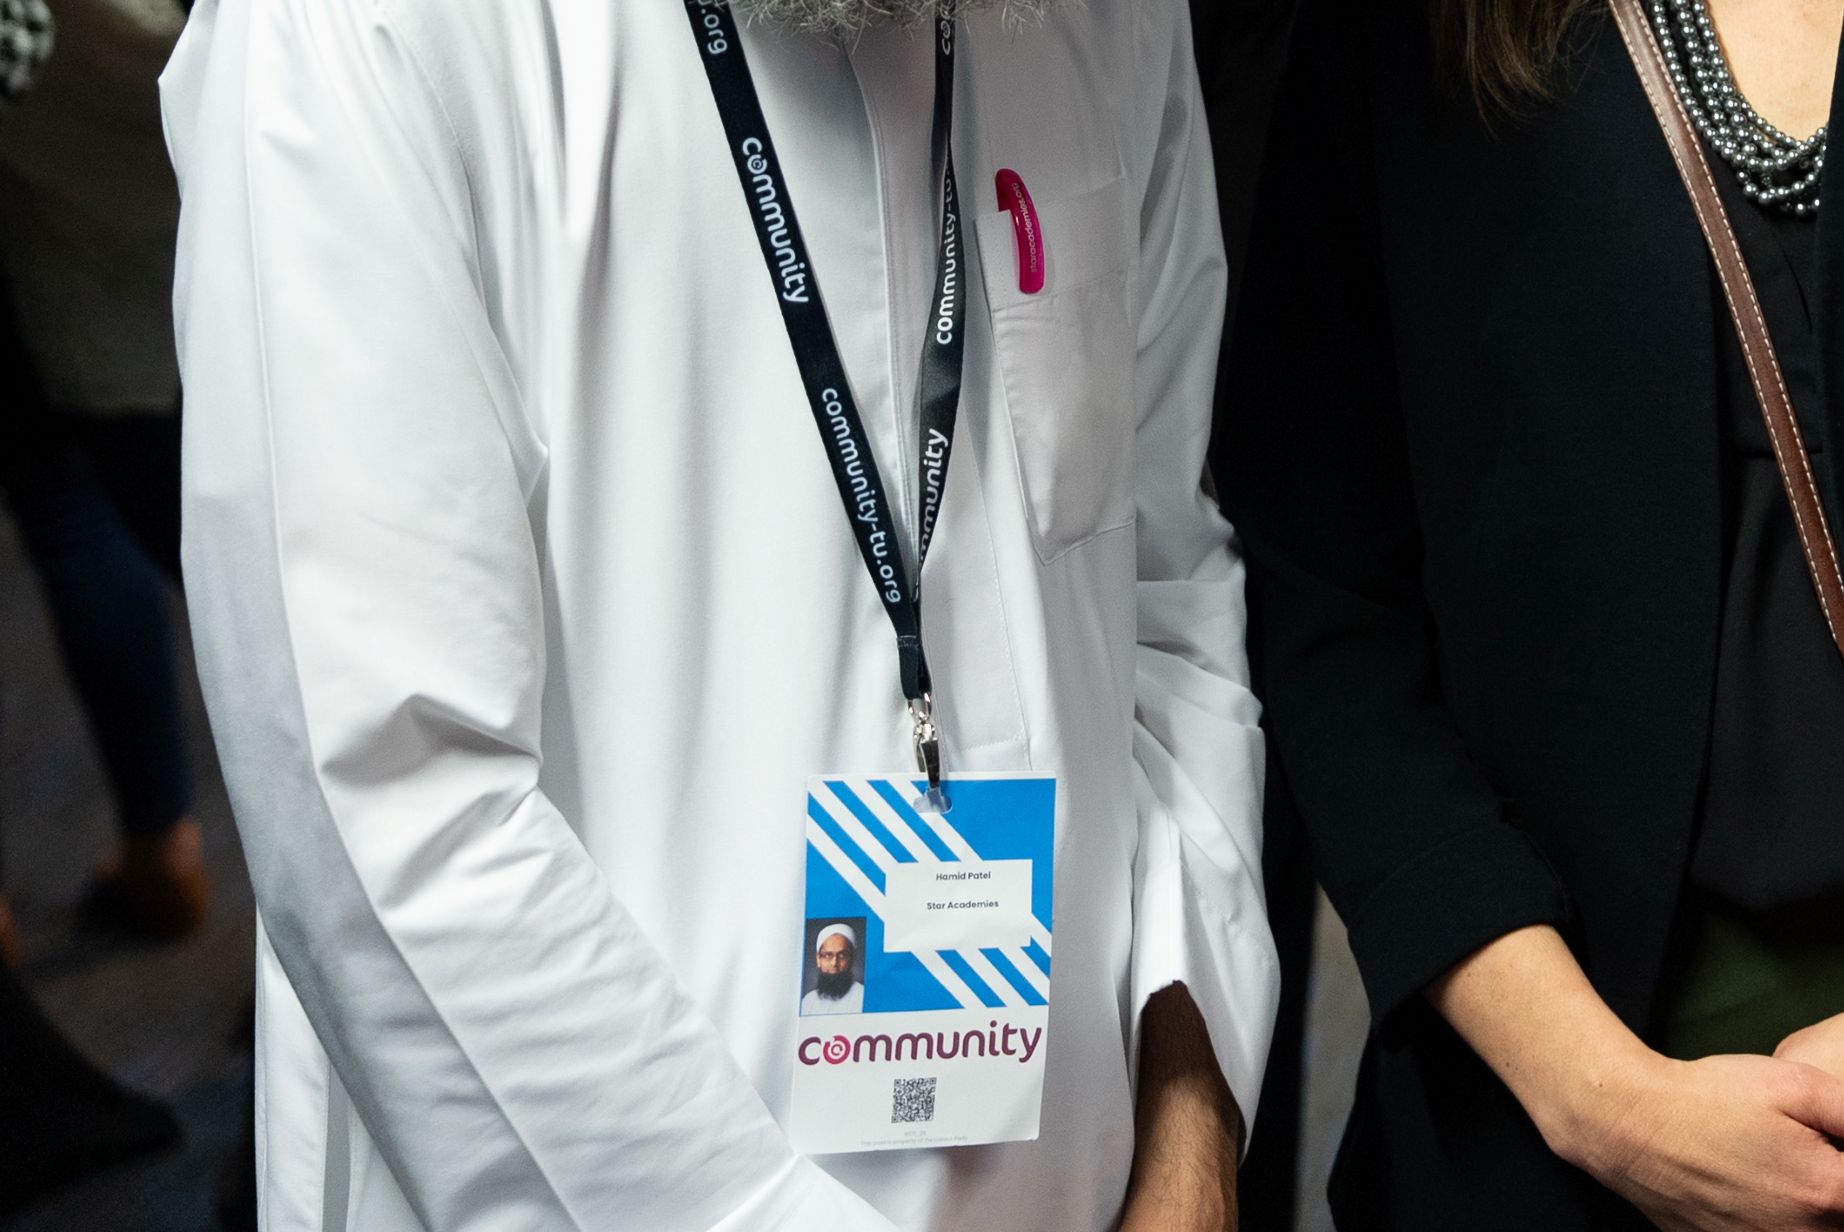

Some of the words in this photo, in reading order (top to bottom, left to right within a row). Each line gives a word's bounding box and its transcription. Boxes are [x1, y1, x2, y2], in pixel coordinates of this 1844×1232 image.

[742, 136, 810, 304] community
[821, 387, 901, 604] community-tu.org
[936, 872, 967, 881] Hamid
[967, 871, 991, 880] Patel
[927, 902, 946, 910] Star
[947, 900, 999, 909] Academies
[798, 1019, 1043, 1066] community
